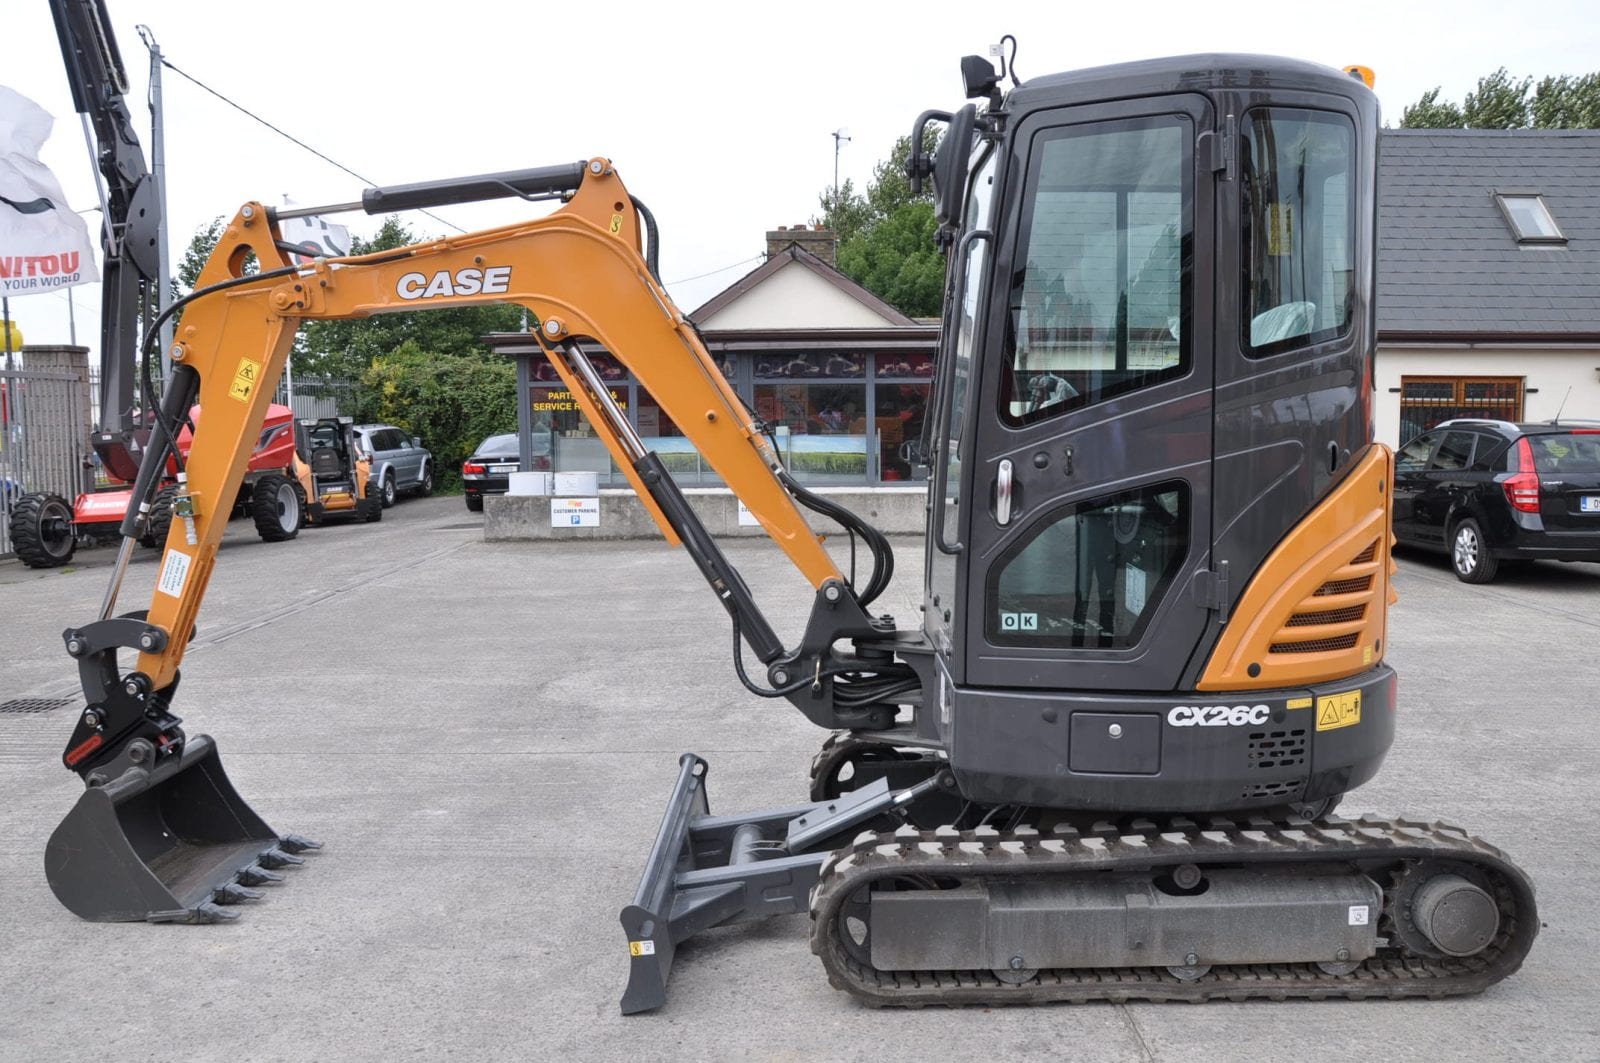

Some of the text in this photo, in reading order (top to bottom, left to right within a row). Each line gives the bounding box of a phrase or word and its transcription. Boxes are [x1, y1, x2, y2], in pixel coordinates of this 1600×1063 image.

[4, 272, 80, 290] YOUR WORLD
[396, 266, 512, 300] CASE
[533, 403, 572, 411] SERVICE
[1167, 704, 1270, 727] CX26C
